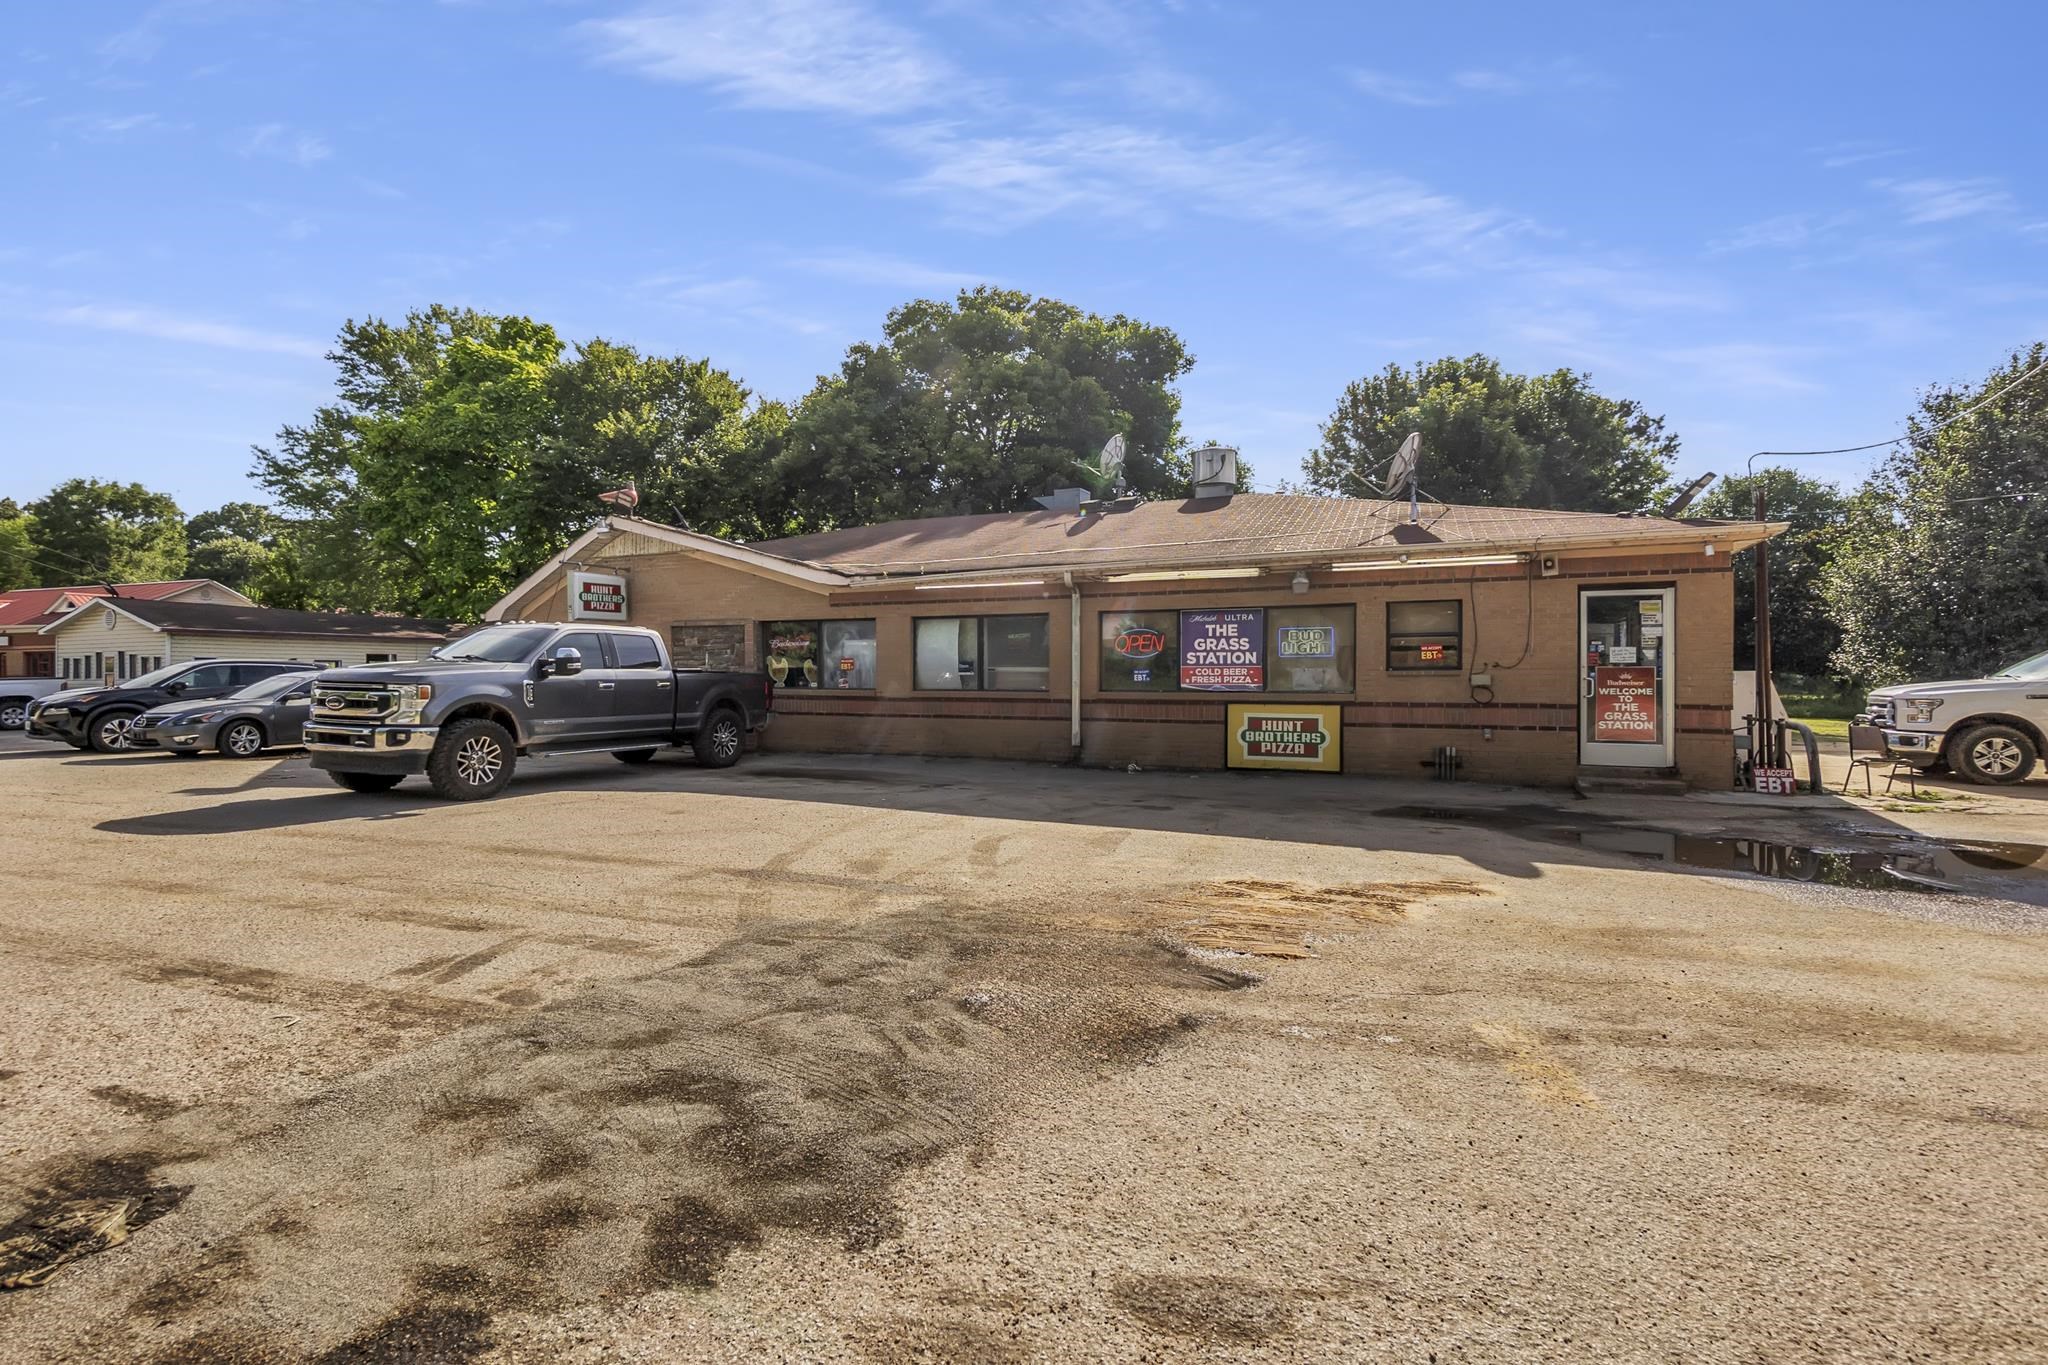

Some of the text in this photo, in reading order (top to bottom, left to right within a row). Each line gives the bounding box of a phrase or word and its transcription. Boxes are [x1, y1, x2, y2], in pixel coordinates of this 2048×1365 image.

[591, 585, 613, 595] HUNT
[581, 592, 623, 604] BROTHERS
[591, 601, 615, 611] PIZZA
[1225, 613, 1254, 621] ULTRA
[1205, 624, 1238, 637] THE
[1289, 630, 1324, 643] BUD
[1115, 634, 1165, 653] OPEN
[1194, 638, 1250, 651] GRASS
[1186, 651, 1257, 665] STATION
[1421, 651, 1438, 660] EBT
[1195, 668, 1248, 676] COLD BEER
[1223, 675, 1252, 683] PIZZA
[1598, 687, 1654, 695] WELCOME
[1618, 695, 1633, 703] TO
[1611, 703, 1639, 711] THE
[1603, 711, 1648, 721] GRASS
[1261, 719, 1304, 732] HUNT
[1598, 720, 1654, 730] STATION
[1245, 731, 1321, 744] BROTHERS
[1261, 742, 1305, 754] PIZZA
[1766, 769, 1793, 777] ACCEPT
[1755, 776, 1794, 794] EBT
